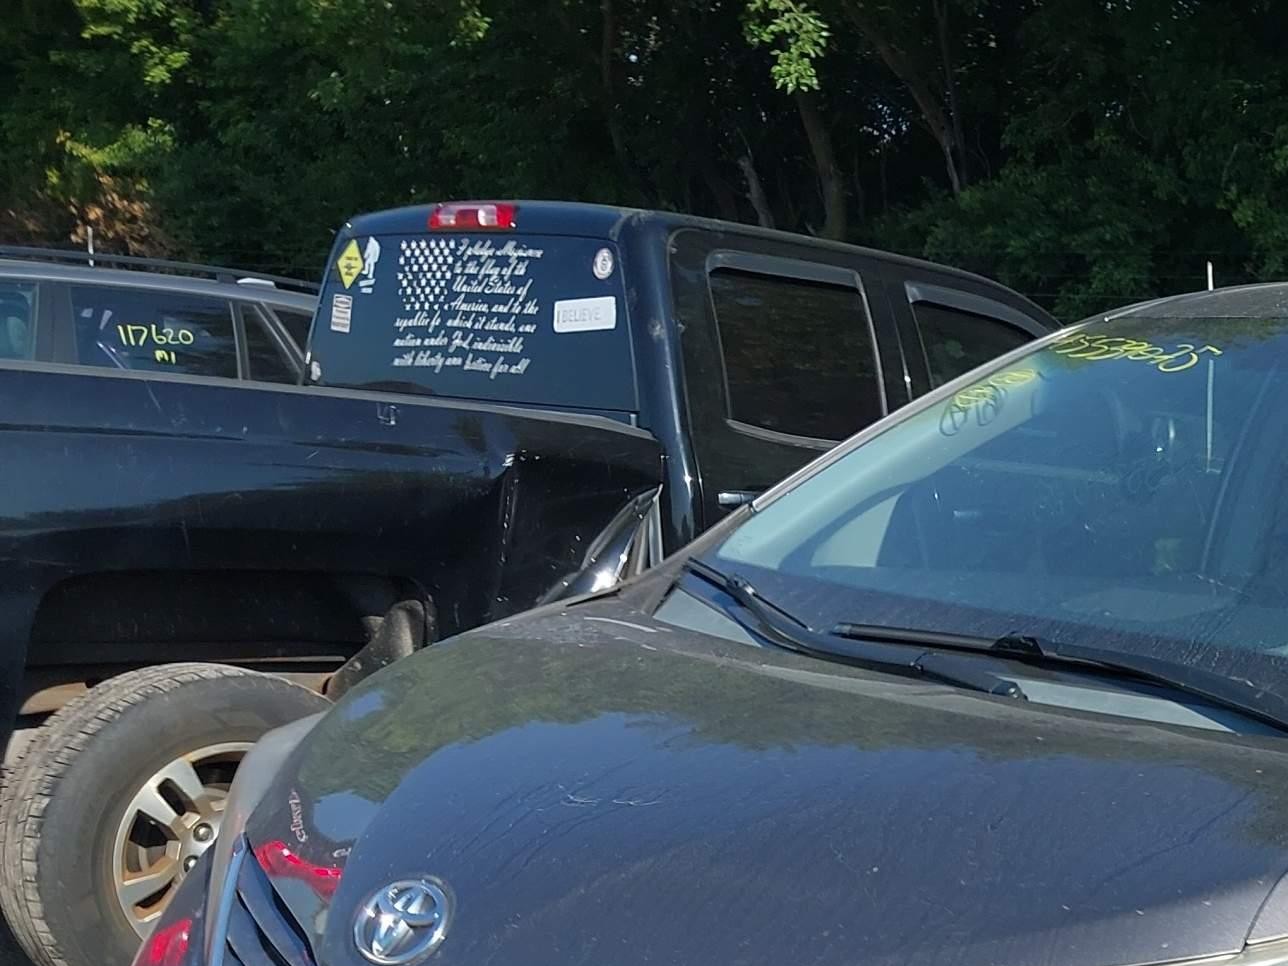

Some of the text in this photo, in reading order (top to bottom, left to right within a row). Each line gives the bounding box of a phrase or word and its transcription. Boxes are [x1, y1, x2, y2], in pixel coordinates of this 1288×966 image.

[464, 260, 480, 275] the
[452, 275, 533, 302] United States of
[491, 297, 514, 313] and
[510, 301, 522, 314] to
[521, 298, 539, 315] the
[446, 311, 475, 329] which
[518, 324, 537, 333] one
[117, 324, 194, 346] 117620
[393, 333, 421, 347] nation
[423, 330, 448, 346] under
[393, 351, 415, 366] with
[414, 350, 446, 374] liberty
